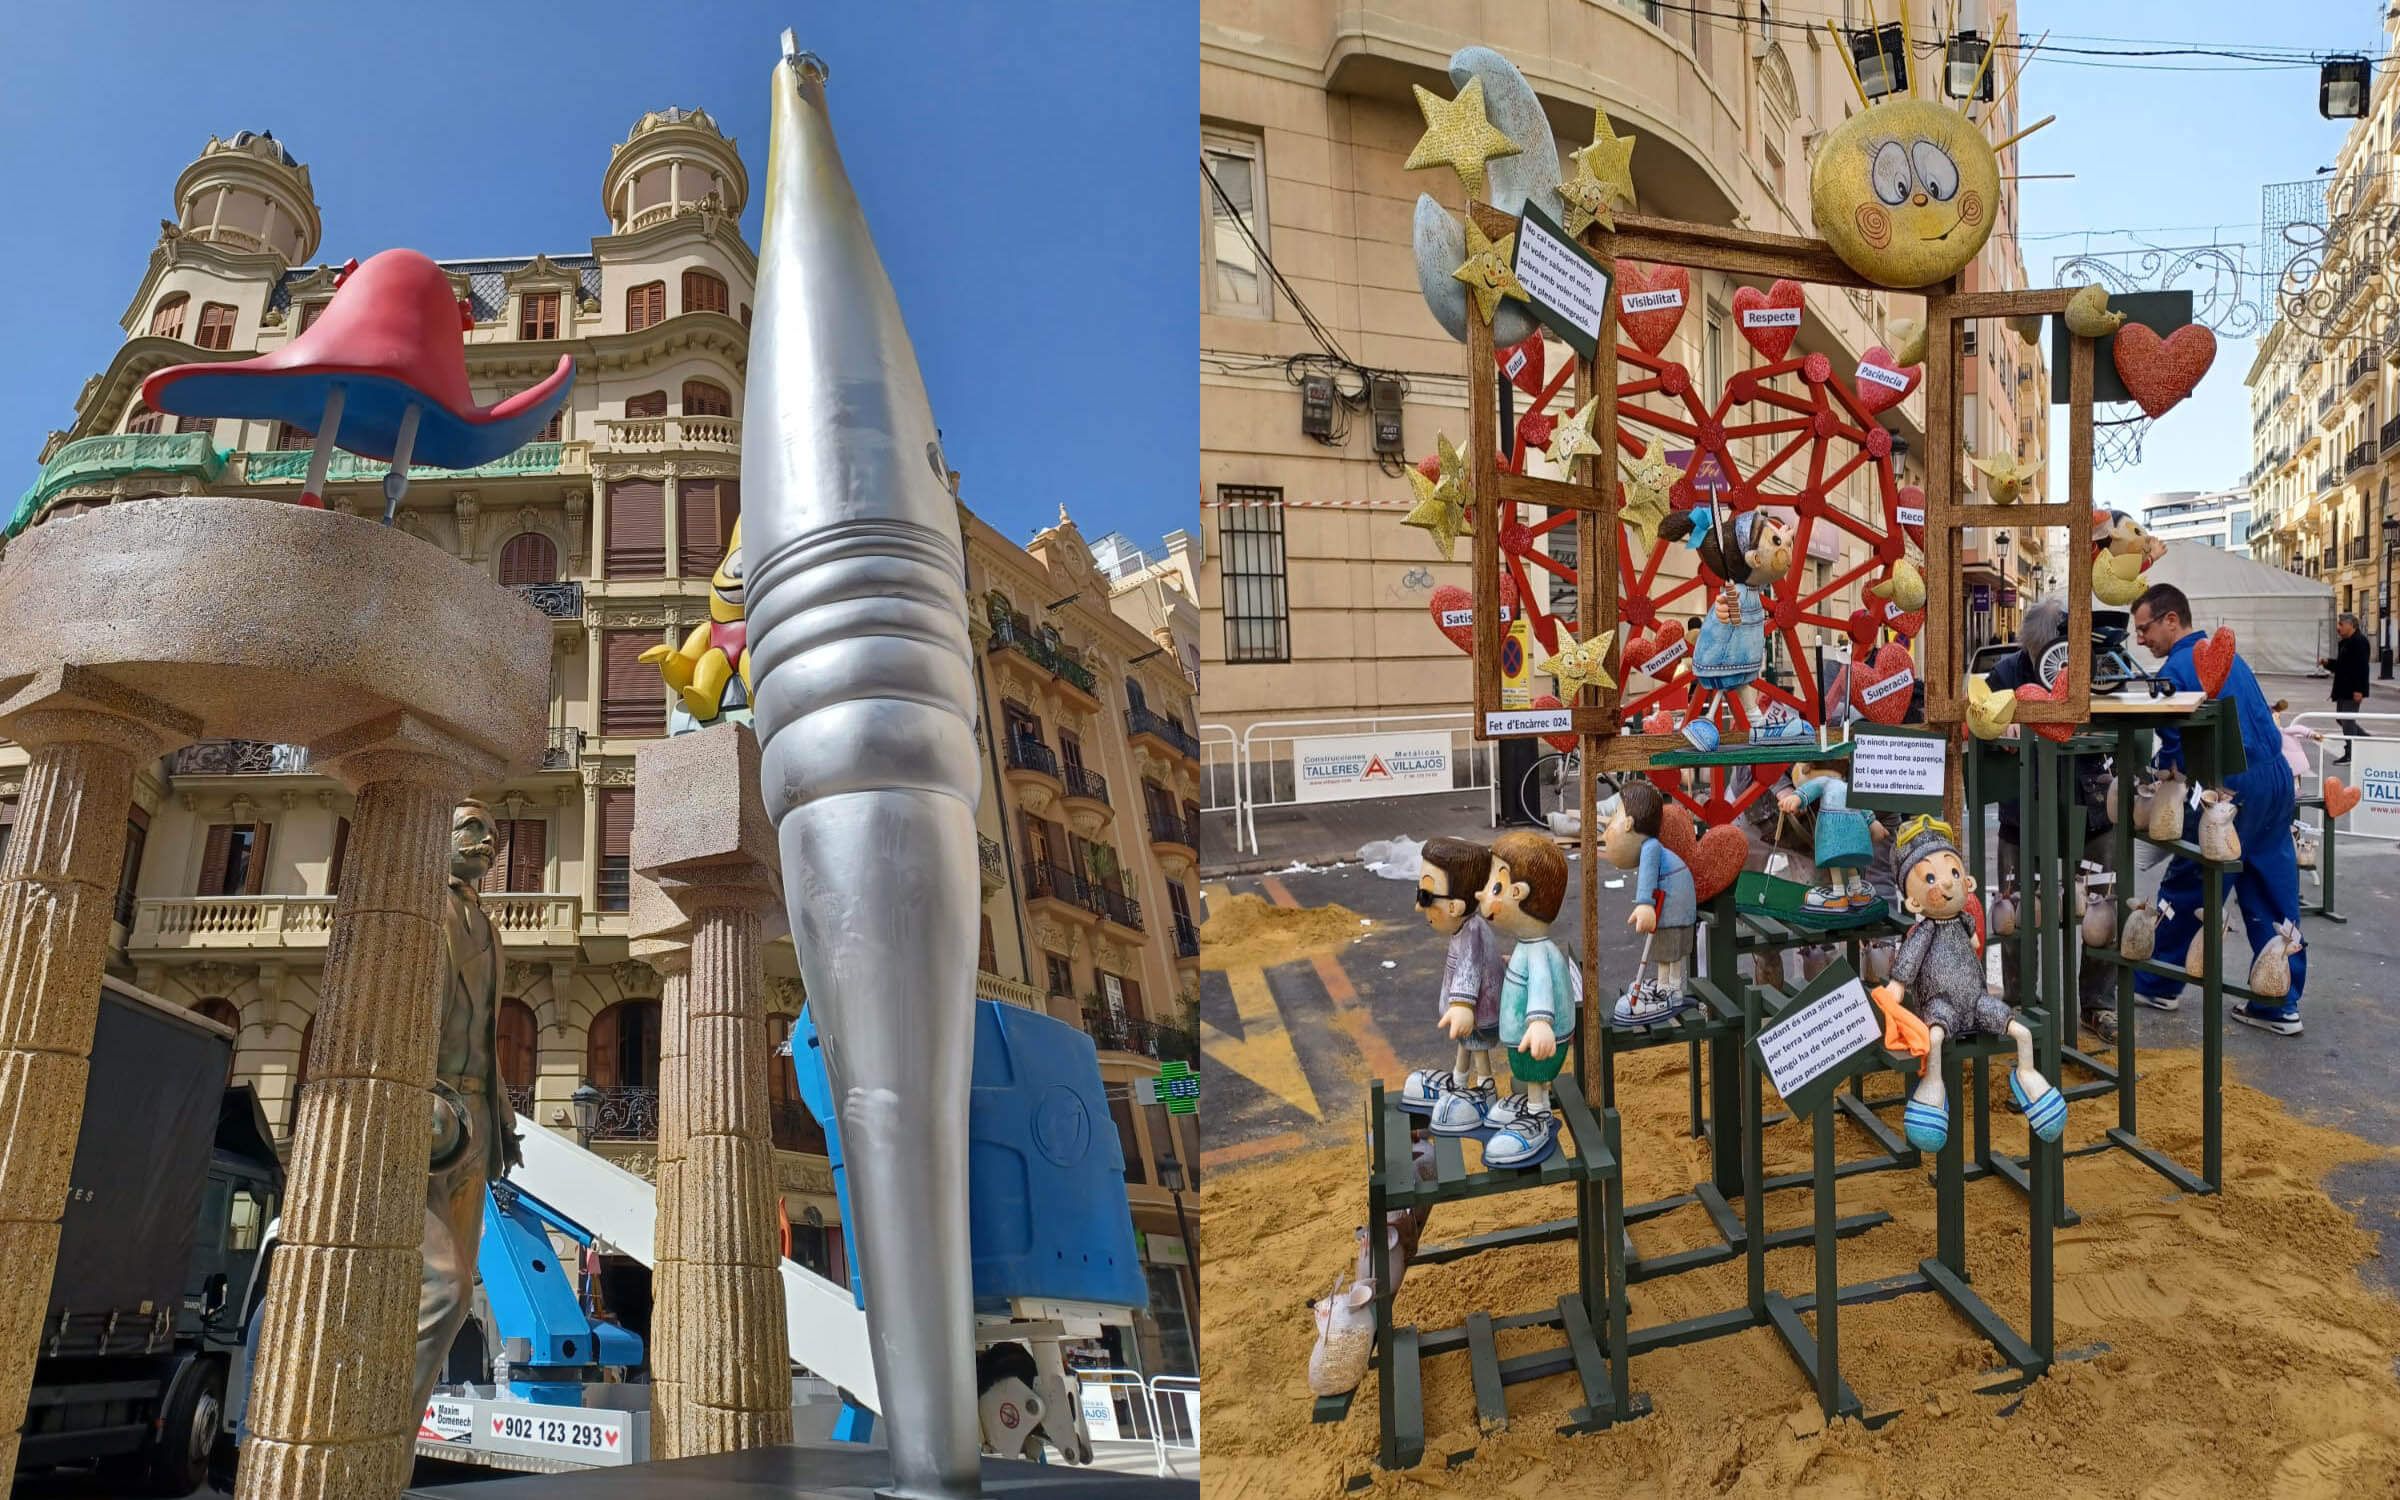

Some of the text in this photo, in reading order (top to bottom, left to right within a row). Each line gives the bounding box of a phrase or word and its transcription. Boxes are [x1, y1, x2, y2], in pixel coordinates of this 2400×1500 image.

[1525, 222, 1535, 236] No
[1536, 233, 1547, 245] cal
[1547, 240, 1557, 253] ser
[1523, 240, 1592, 296] ni voler salvar el món,
[1517, 273, 1529, 285] per
[1530, 281, 1537, 291] la
[1537, 288, 1556, 305] plena
[1520, 257, 1600, 318] sobra amb voler treballar
[1627, 293, 1677, 309] Visibilitat
[1749, 312, 1796, 324] Respecte
[1861, 366, 1902, 387] Paciència
[1645, 644, 1684, 672] Tenacitat
[1866, 674, 1909, 700] Superació
[1489, 720, 1503, 731] Fet
[1507, 718, 1549, 730] d'Encàrrec
[1856, 737, 1934, 749] Els ninots protagonistes
[1304, 753, 1366, 764] Construcciones
[1877, 753, 1892, 761] molt
[1894, 753, 1911, 761] bona
[1305, 763, 1360, 777] TALLERES
[1365, 758, 1388, 778] A
[1392, 758, 1443, 771] VILLAJOS
[1898, 768, 1907, 776] de
[1909, 768, 1915, 776] la
[2364, 768, 2400, 779] Const
[1865, 781, 1871, 789] la
[2366, 784, 2400, 800] TALL
[1760, 992, 1845, 1047] Nadant és una sirena,
[1768, 1050, 1782, 1064] per
[1783, 1036, 1802, 1052] terra
[1803, 1018, 1833, 1038] tampoc
[1833, 1011, 1843, 1020] va
[1774, 1015, 1866, 1078] Ningú ha de tindre pena
[1781, 1034, 1866, 1093] d'una persona normal.
[70, 1187, 94, 1202] ES
[438, 1404, 459, 1415] Maxim
[437, 1414, 471, 1427] Domenech
[505, 1417, 602, 1447] 902 123 293
